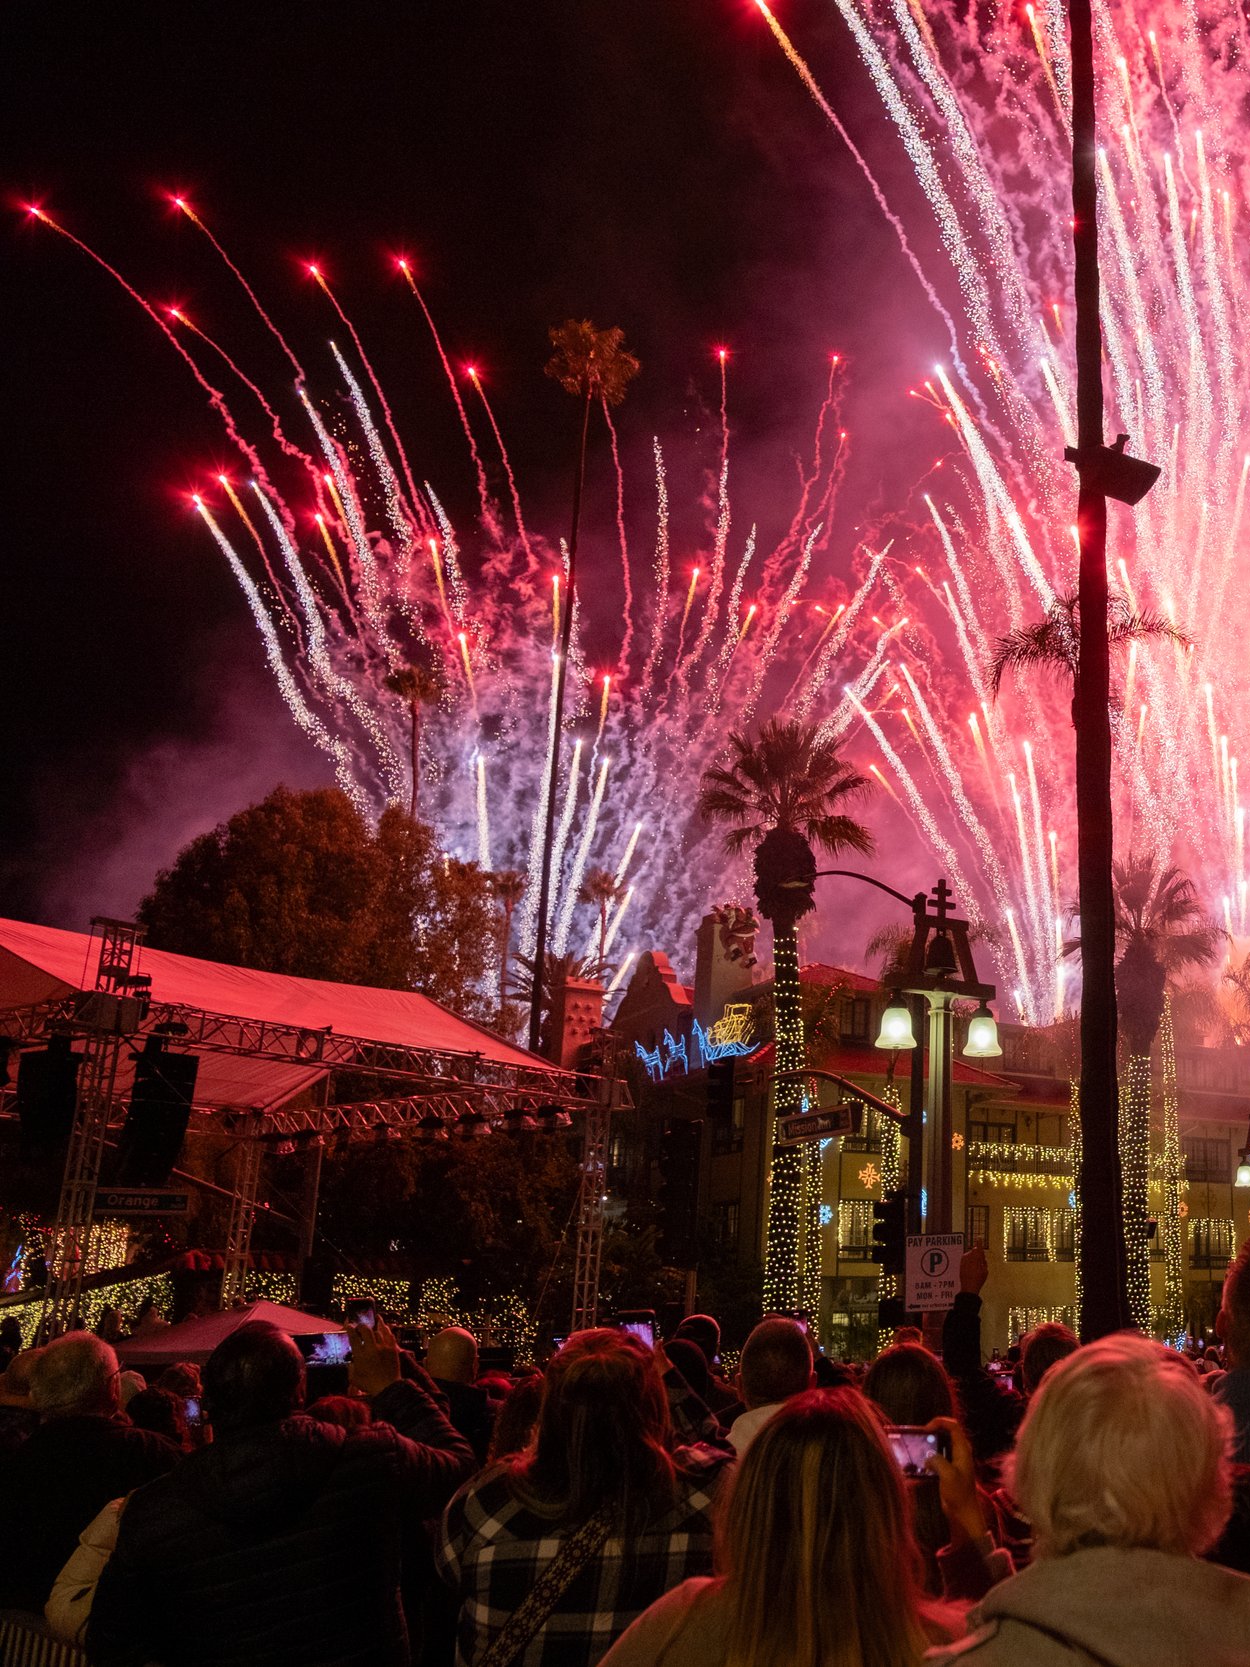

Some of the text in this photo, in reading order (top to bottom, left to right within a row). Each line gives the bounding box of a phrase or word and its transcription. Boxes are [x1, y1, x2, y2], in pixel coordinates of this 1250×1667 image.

[787, 1120, 817, 1137] Mission
[107, 1194, 159, 1209] Orange
[908, 1235, 962, 1247] PAY PARKING
[930, 1252, 942, 1273] P
[938, 1280, 955, 1289] 7PM
[917, 1292, 933, 1300] MON
[941, 1290, 953, 1299] FRI
